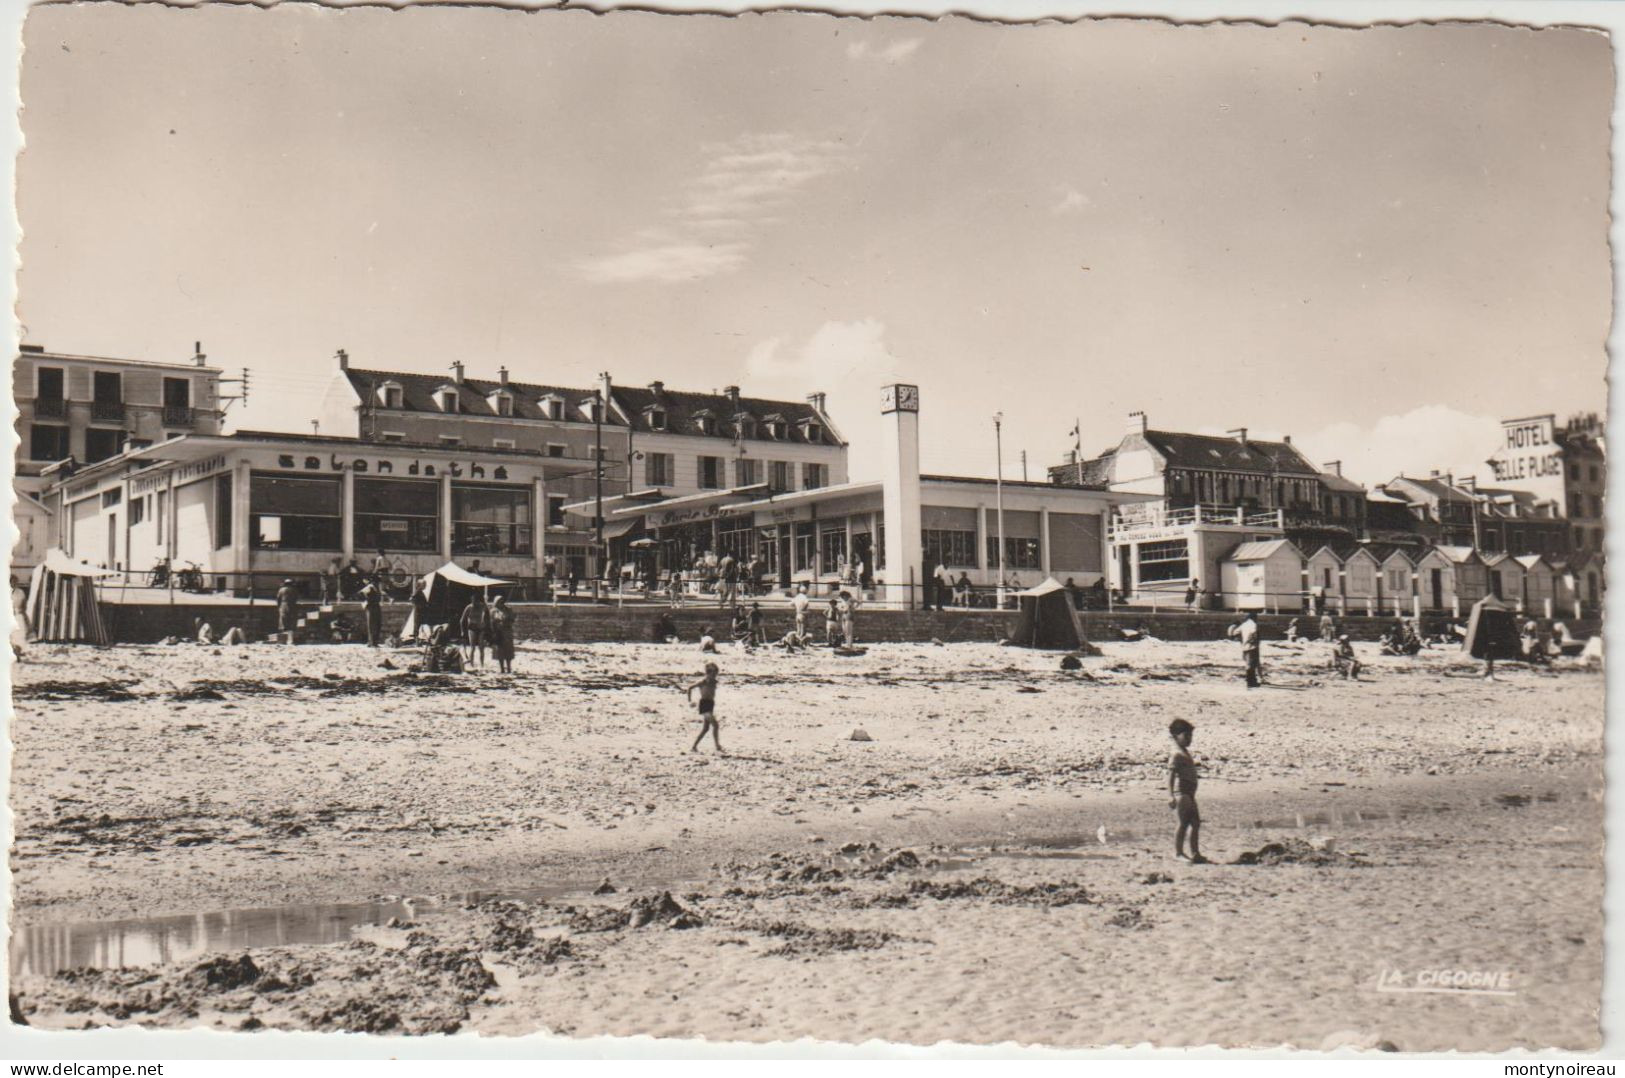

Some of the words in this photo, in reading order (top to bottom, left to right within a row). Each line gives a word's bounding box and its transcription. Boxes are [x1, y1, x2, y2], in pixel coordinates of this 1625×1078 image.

[1506, 424, 1549, 449] HOTEL
[1495, 457, 1525, 481] BELLE
[1529, 454, 1560, 478] PLAGE
